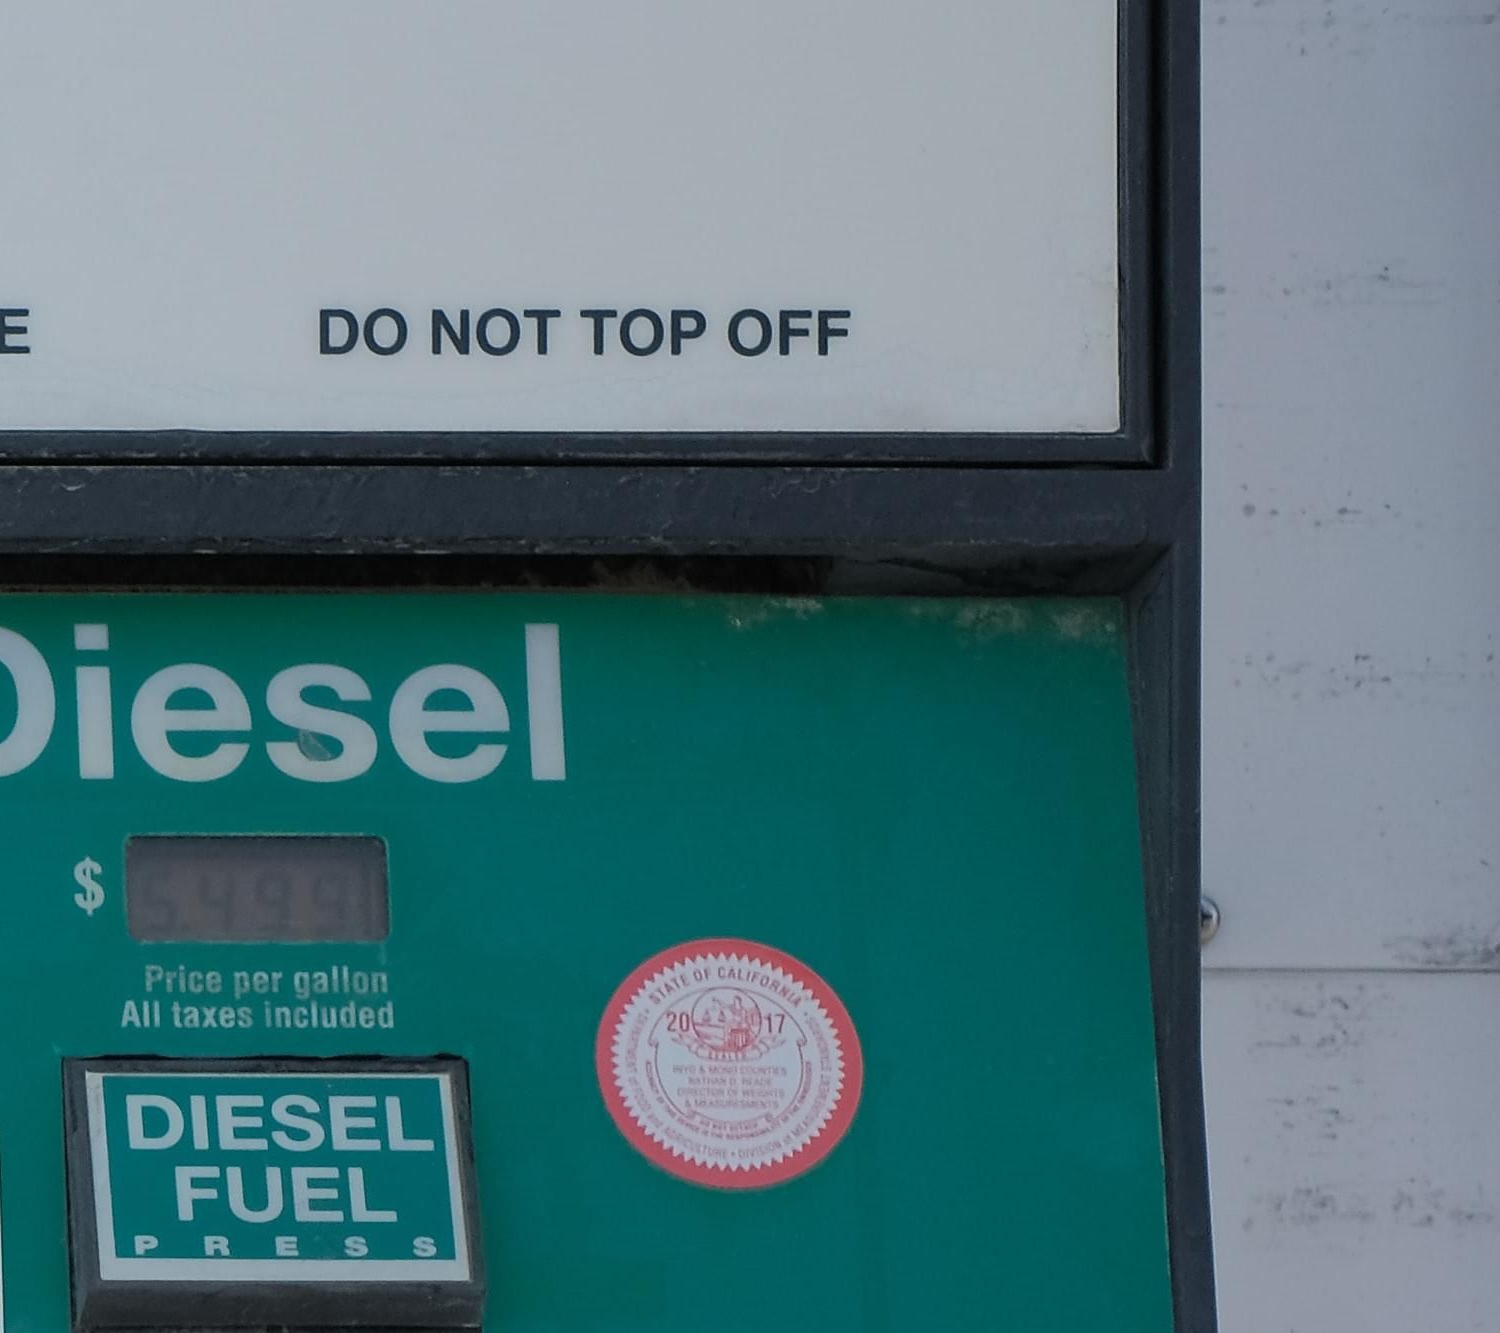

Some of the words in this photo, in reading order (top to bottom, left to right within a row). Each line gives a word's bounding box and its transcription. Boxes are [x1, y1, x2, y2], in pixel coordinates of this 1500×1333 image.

[319, 306, 407, 357] DO
[430, 306, 560, 357] NOT
[579, 306, 705, 357] TOP
[725, 306, 851, 357] OFF
[73, 857, 104, 916] $
[145, 965, 222, 993] Price
[234, 970, 282, 999] per
[294, 966, 388, 999] gallon
[648, 976, 690, 1005] STATE
[693, 968, 709, 982] OF
[718, 965, 801, 1007] CALIFORNIA
[120, 1000, 160, 1027] All
[172, 1002, 253, 1028] taxes
[264, 1001, 395, 1029] included
[126, 1094, 434, 1151] DIESEL
[175, 1166, 397, 1223] FUEL
[134, 1235, 437, 1257] PRESS
